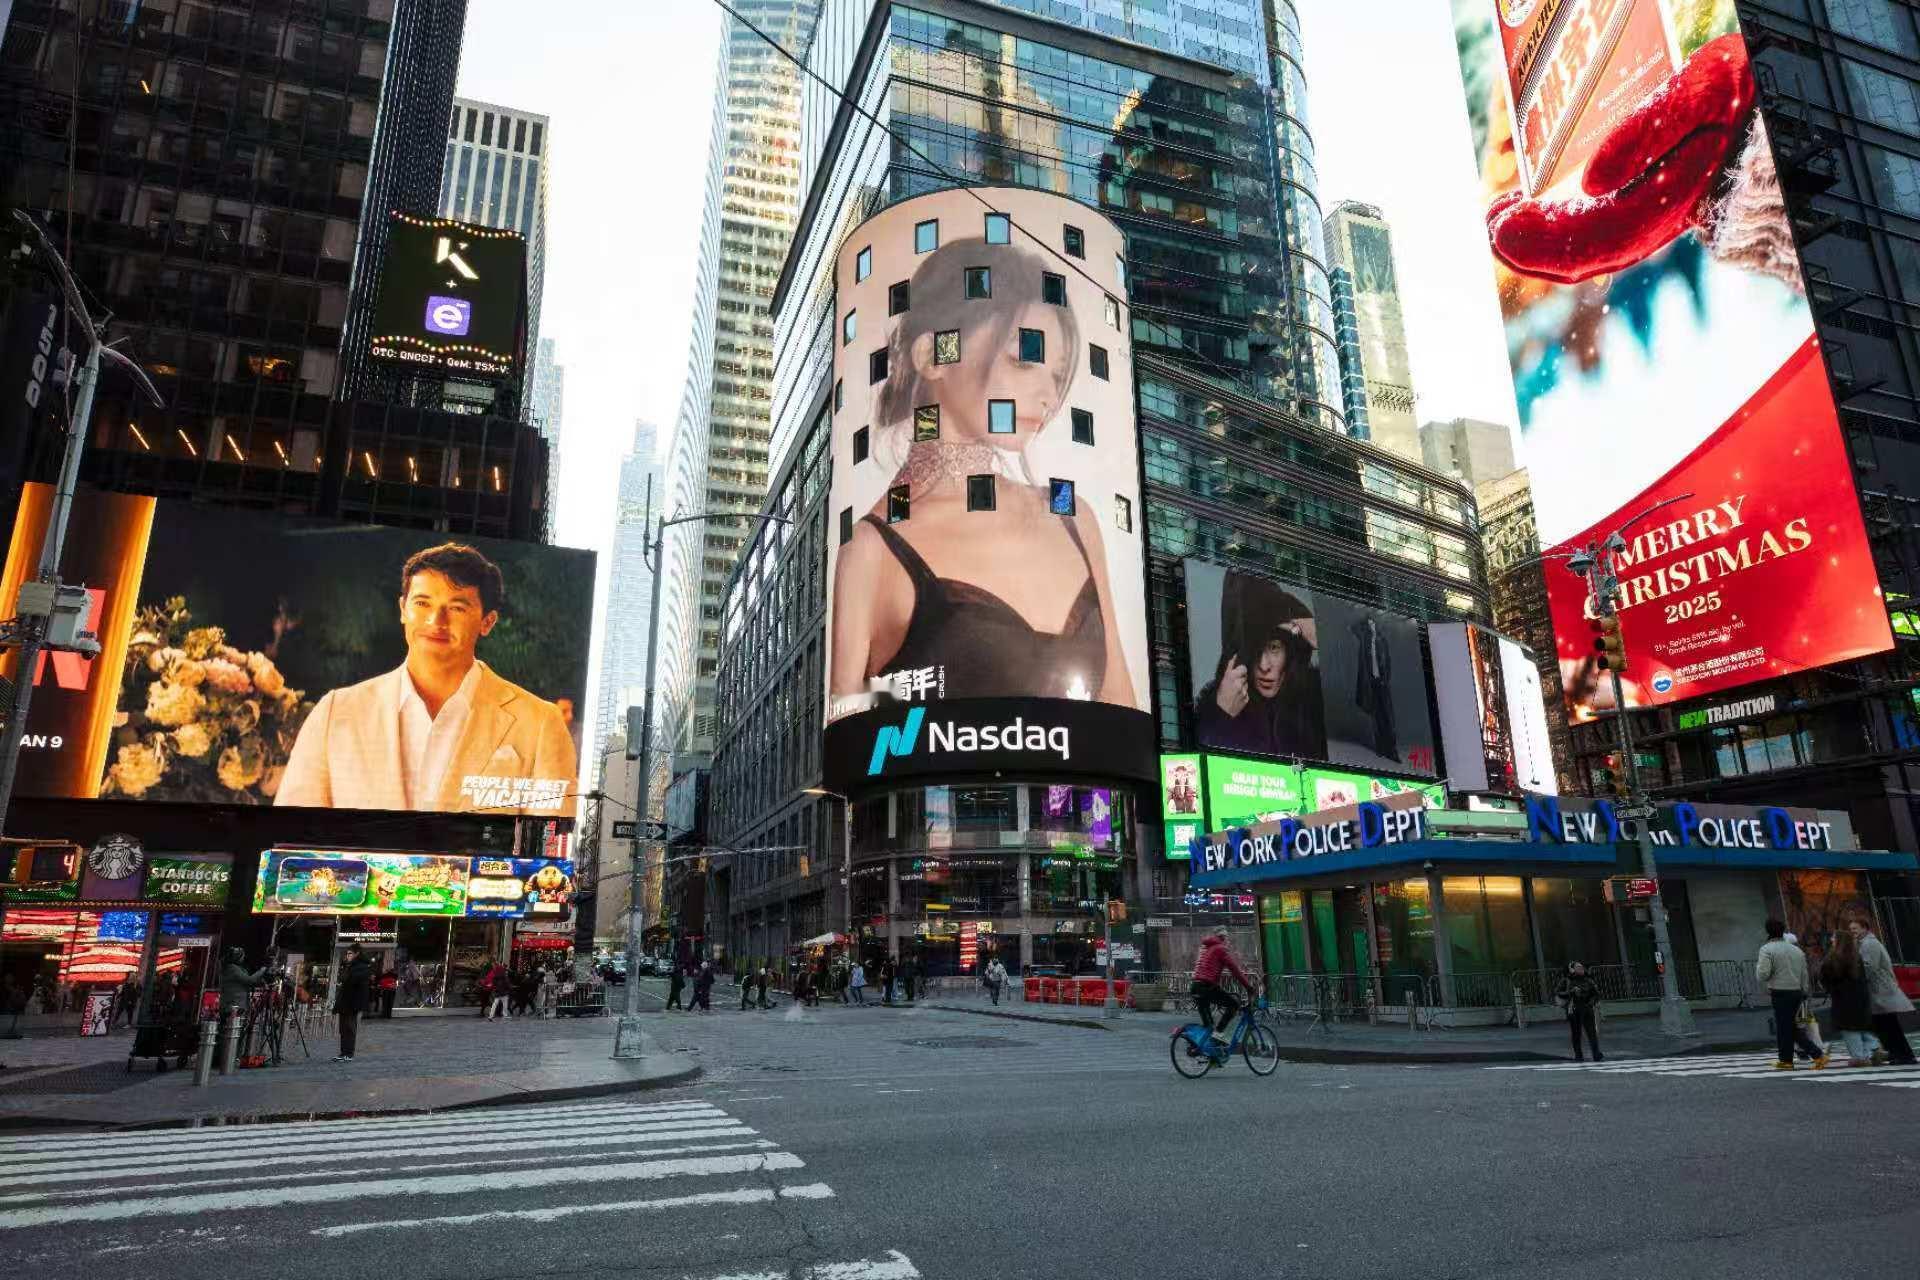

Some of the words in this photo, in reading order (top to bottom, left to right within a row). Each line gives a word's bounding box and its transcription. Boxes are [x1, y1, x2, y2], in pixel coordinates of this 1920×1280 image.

[372, 346, 398, 359] OTC:
[1616, 495, 1746, 571] MERRY
[1664, 590, 1722, 625] 2025
[20, 734, 47, 748] AN
[50, 735, 63, 748] 9
[929, 717, 1070, 761] Nasdaq
[472, 788, 565, 810] VACATION
[1527, 794, 1597, 844] NEW
[1674, 802, 1765, 849] POLICE
[1769, 807, 1832, 850] DEPT
[1190, 836, 1225, 874] NEW
[1226, 828, 1276, 868] YORK
[1280, 818, 1351, 862] POLICE
[1359, 801, 1424, 848] DEPT
[151, 867, 229, 882] STARBUCKS
[161, 882, 212, 894] COFFEE
